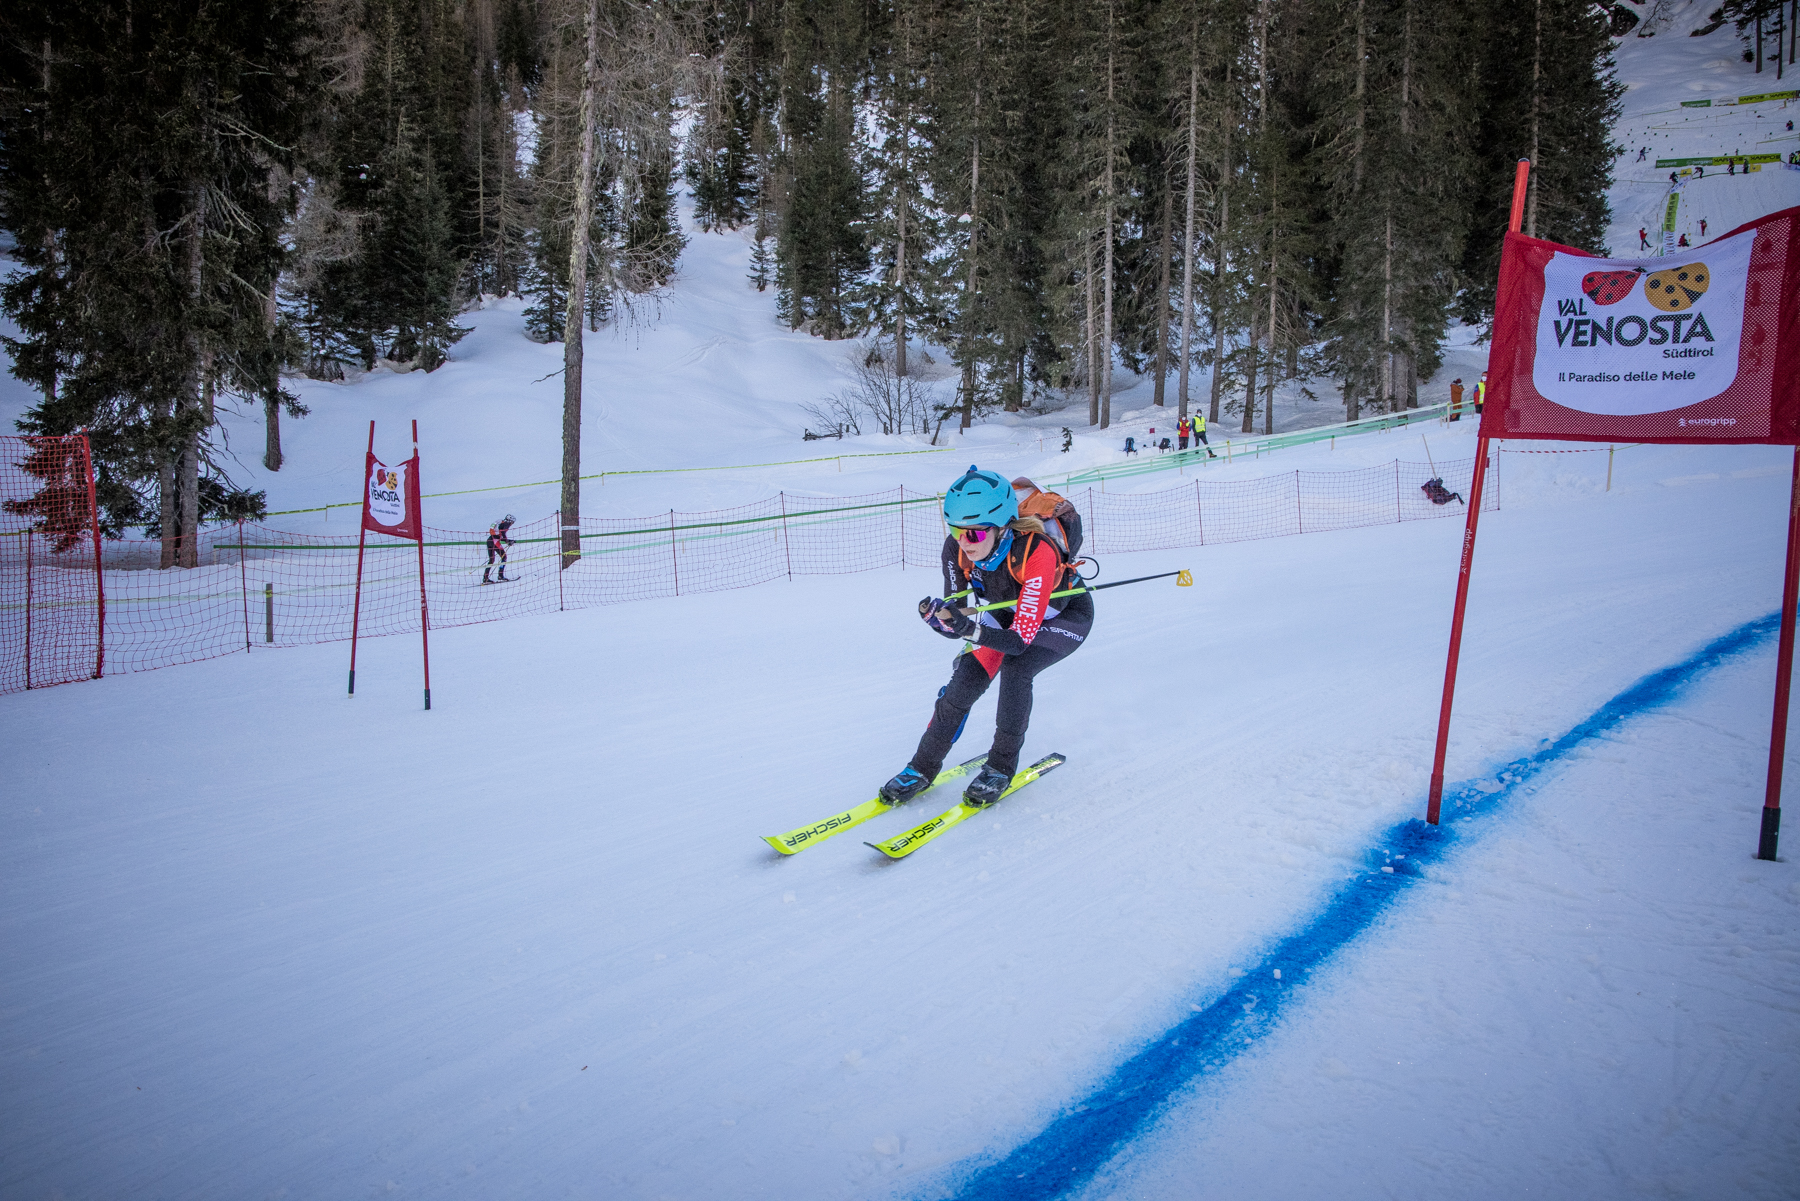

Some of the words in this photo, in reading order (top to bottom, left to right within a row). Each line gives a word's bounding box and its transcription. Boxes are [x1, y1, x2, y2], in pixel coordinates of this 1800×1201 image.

[1557, 298, 1587, 317] VAL
[1553, 312, 1716, 349] VENOSTA
[1662, 347, 1715, 360] Südtirol
[1558, 372, 1566, 382] Il
[1568, 372, 1621, 383] Paradiso
[1623, 371, 1659, 382] delle
[1661, 370, 1697, 381] Mele
[1688, 417, 1737, 427] eurogripp
[1018, 576, 1043, 621] FRANCE
[784, 813, 852, 847] FISCHER
[887, 818, 946, 852] FISCHER
